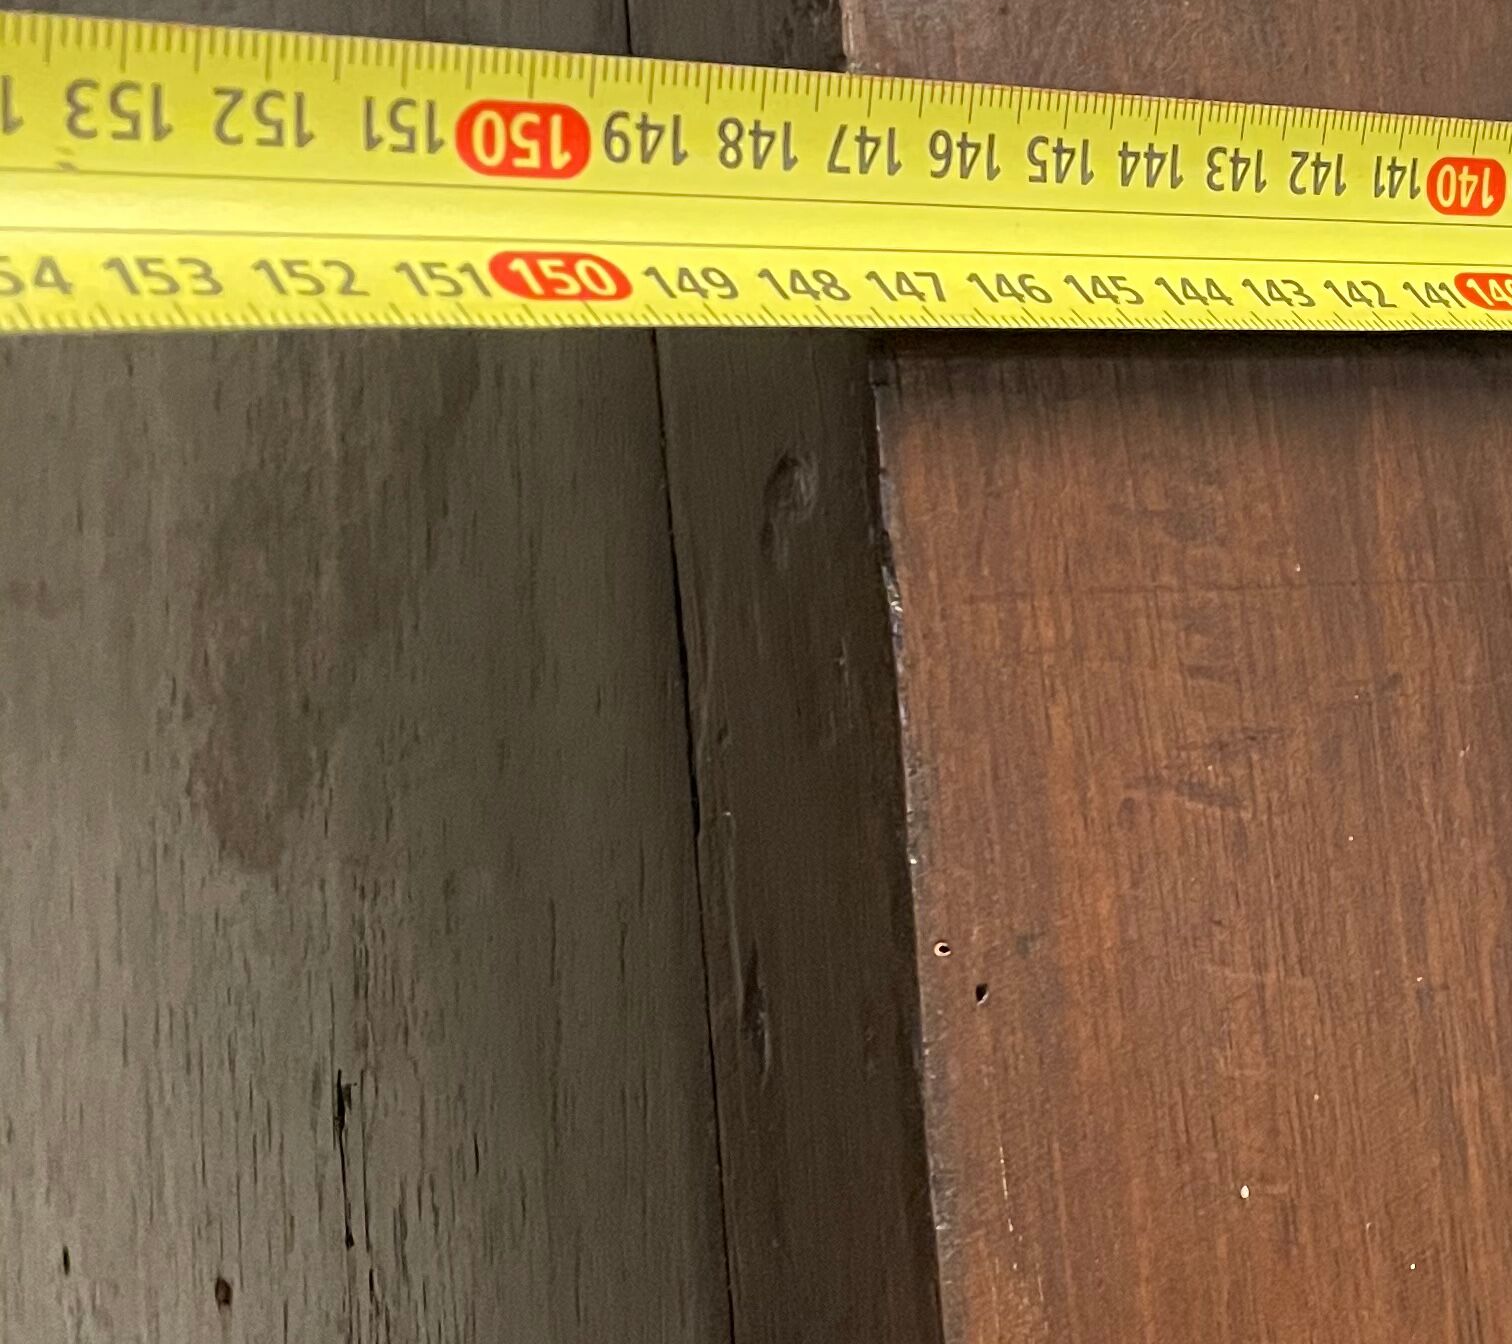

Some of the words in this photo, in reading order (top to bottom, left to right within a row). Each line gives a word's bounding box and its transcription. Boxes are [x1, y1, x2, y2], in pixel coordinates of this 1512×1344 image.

[64, 78, 173, 143] 153
[212, 86, 316, 148] 152
[363, 95, 446, 155] 151
[472, 110, 571, 168] 150
[603, 110, 688, 167] 149
[718, 116, 799, 171] 148
[827, 123, 902, 176] 147
[929, 129, 1001, 183] 146
[1028, 135, 1095, 185] 145
[1118, 141, 1183, 190] 144
[1206, 145, 1267, 194] 143
[1289, 150, 1346, 197] 142
[1373, 155, 1421, 201] 141
[1436, 164, 1494, 209] 140
[0, 255, 72, 297] 54
[103, 256, 223, 296] 153
[251, 258, 368, 297] 152
[395, 260, 491, 298] 151
[507, 257, 614, 298] 150
[644, 266, 738, 300] 149
[758, 267, 851, 302] 148
[865, 269, 947, 302] 147
[966, 271, 1052, 304] 146
[1063, 273, 1144, 306] 145
[1154, 275, 1232, 307] 144
[1241, 277, 1315, 308] 143
[1323, 279, 1397, 310] 142
[1402, 281, 1461, 311] 141
